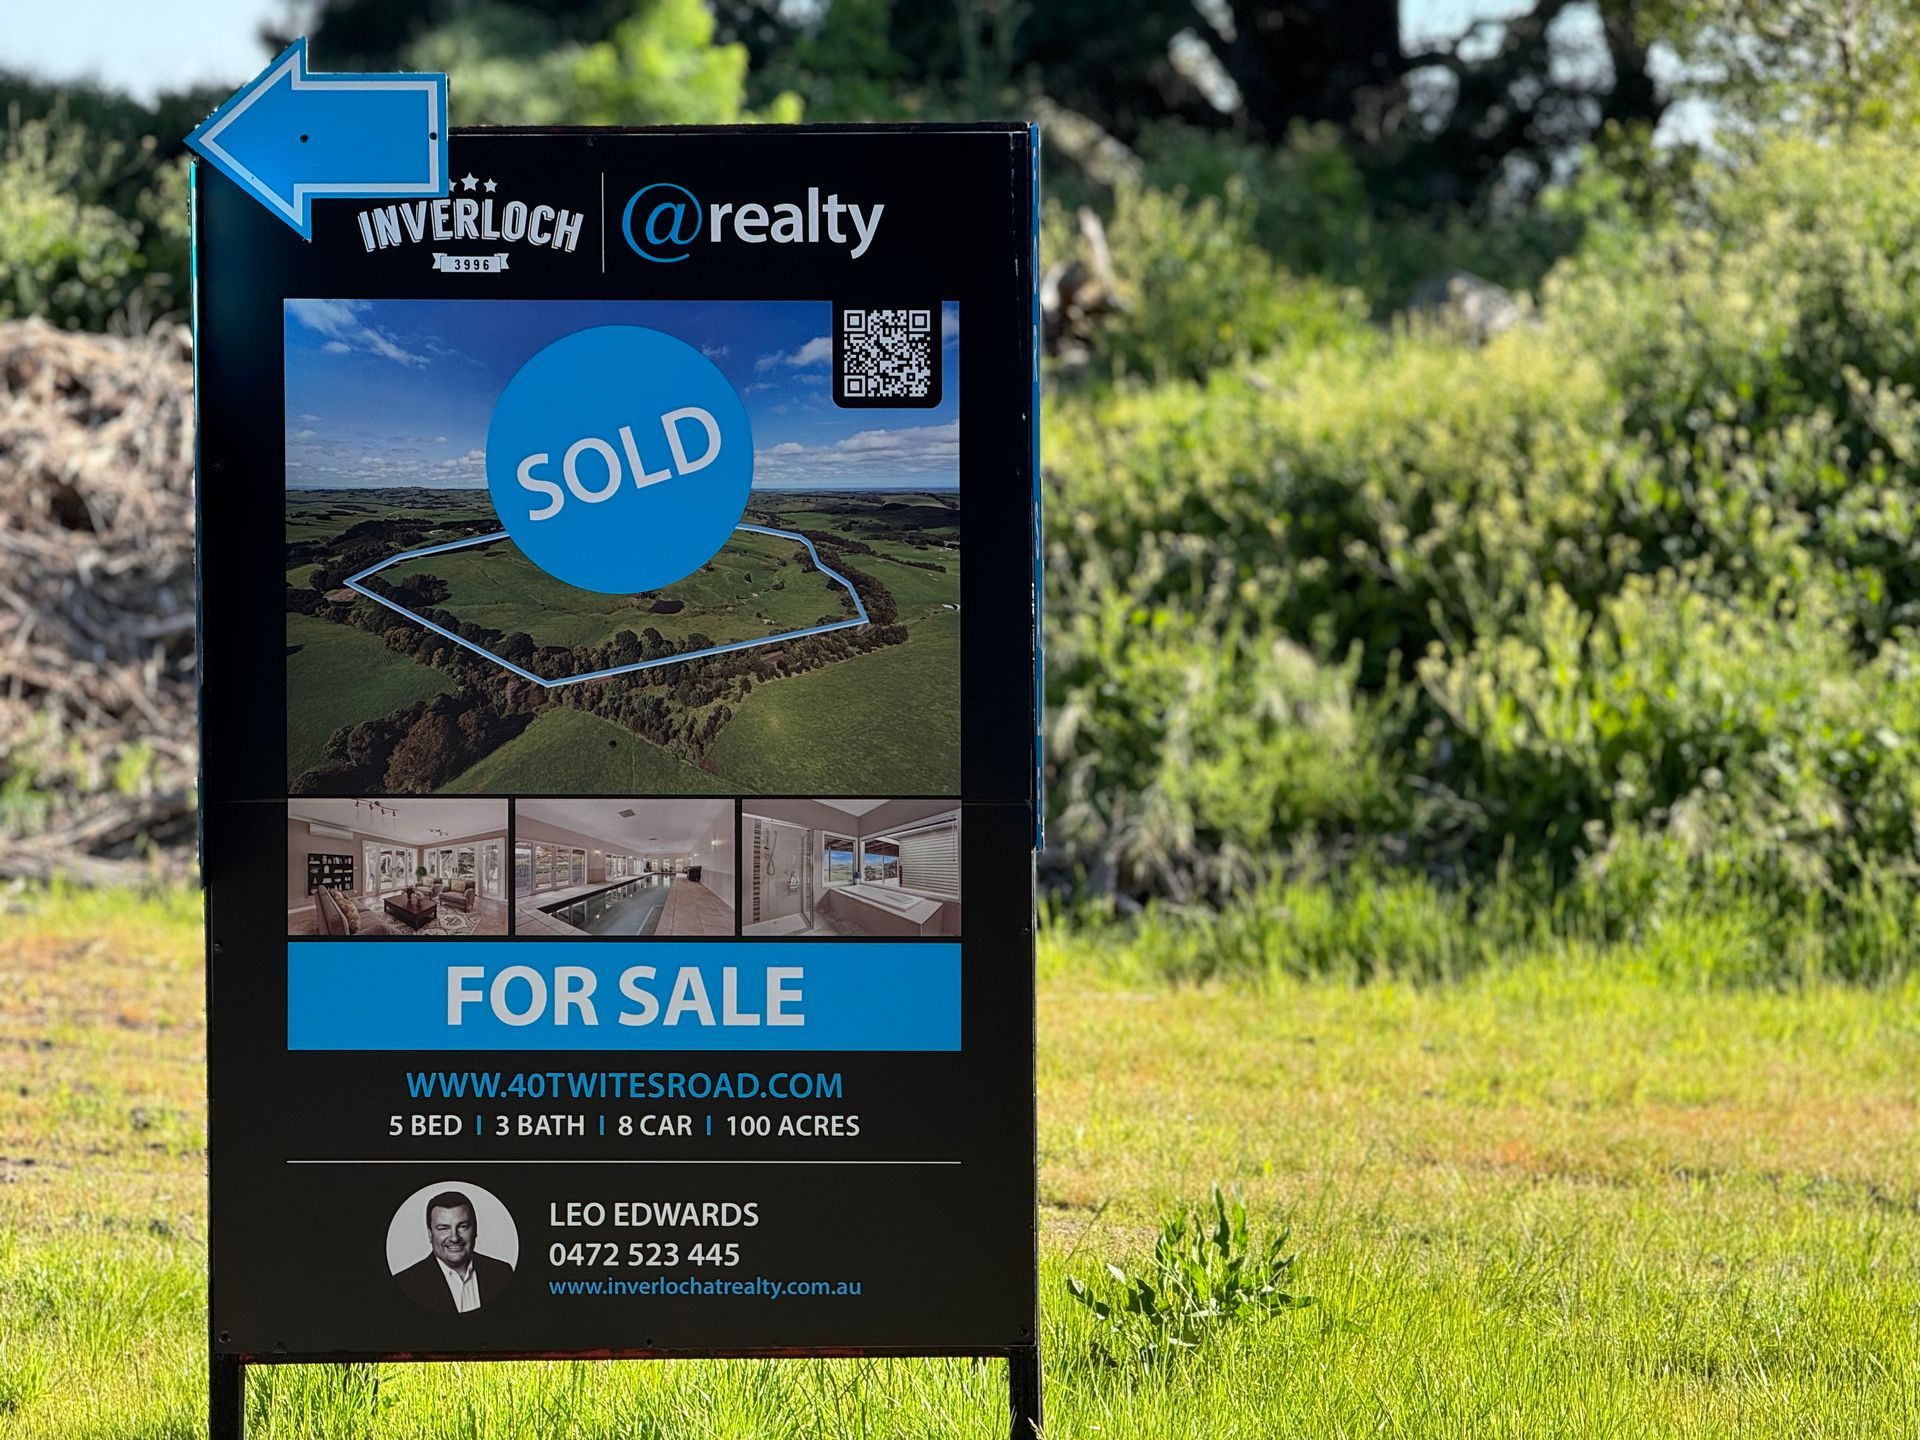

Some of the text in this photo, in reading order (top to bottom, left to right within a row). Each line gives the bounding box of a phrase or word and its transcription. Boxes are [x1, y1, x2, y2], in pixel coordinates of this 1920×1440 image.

[358, 198, 584, 253] INVERLOCH
[454, 258, 490, 271] 3996
[517, 407, 722, 521] SOLD
[447, 966, 804, 1027] FOR SALE
[406, 1073, 843, 1100] WWW.40TWITESROAD.COM
[389, 1115, 860, 1137] 5 BED 3 BATH 8 CAR 100 ACRES
[549, 1202, 759, 1227] LEO EDWARDS
[549, 1243, 740, 1267] 0472 523 445
[549, 1276, 862, 1300] www.inverlochatrealty.com.au
